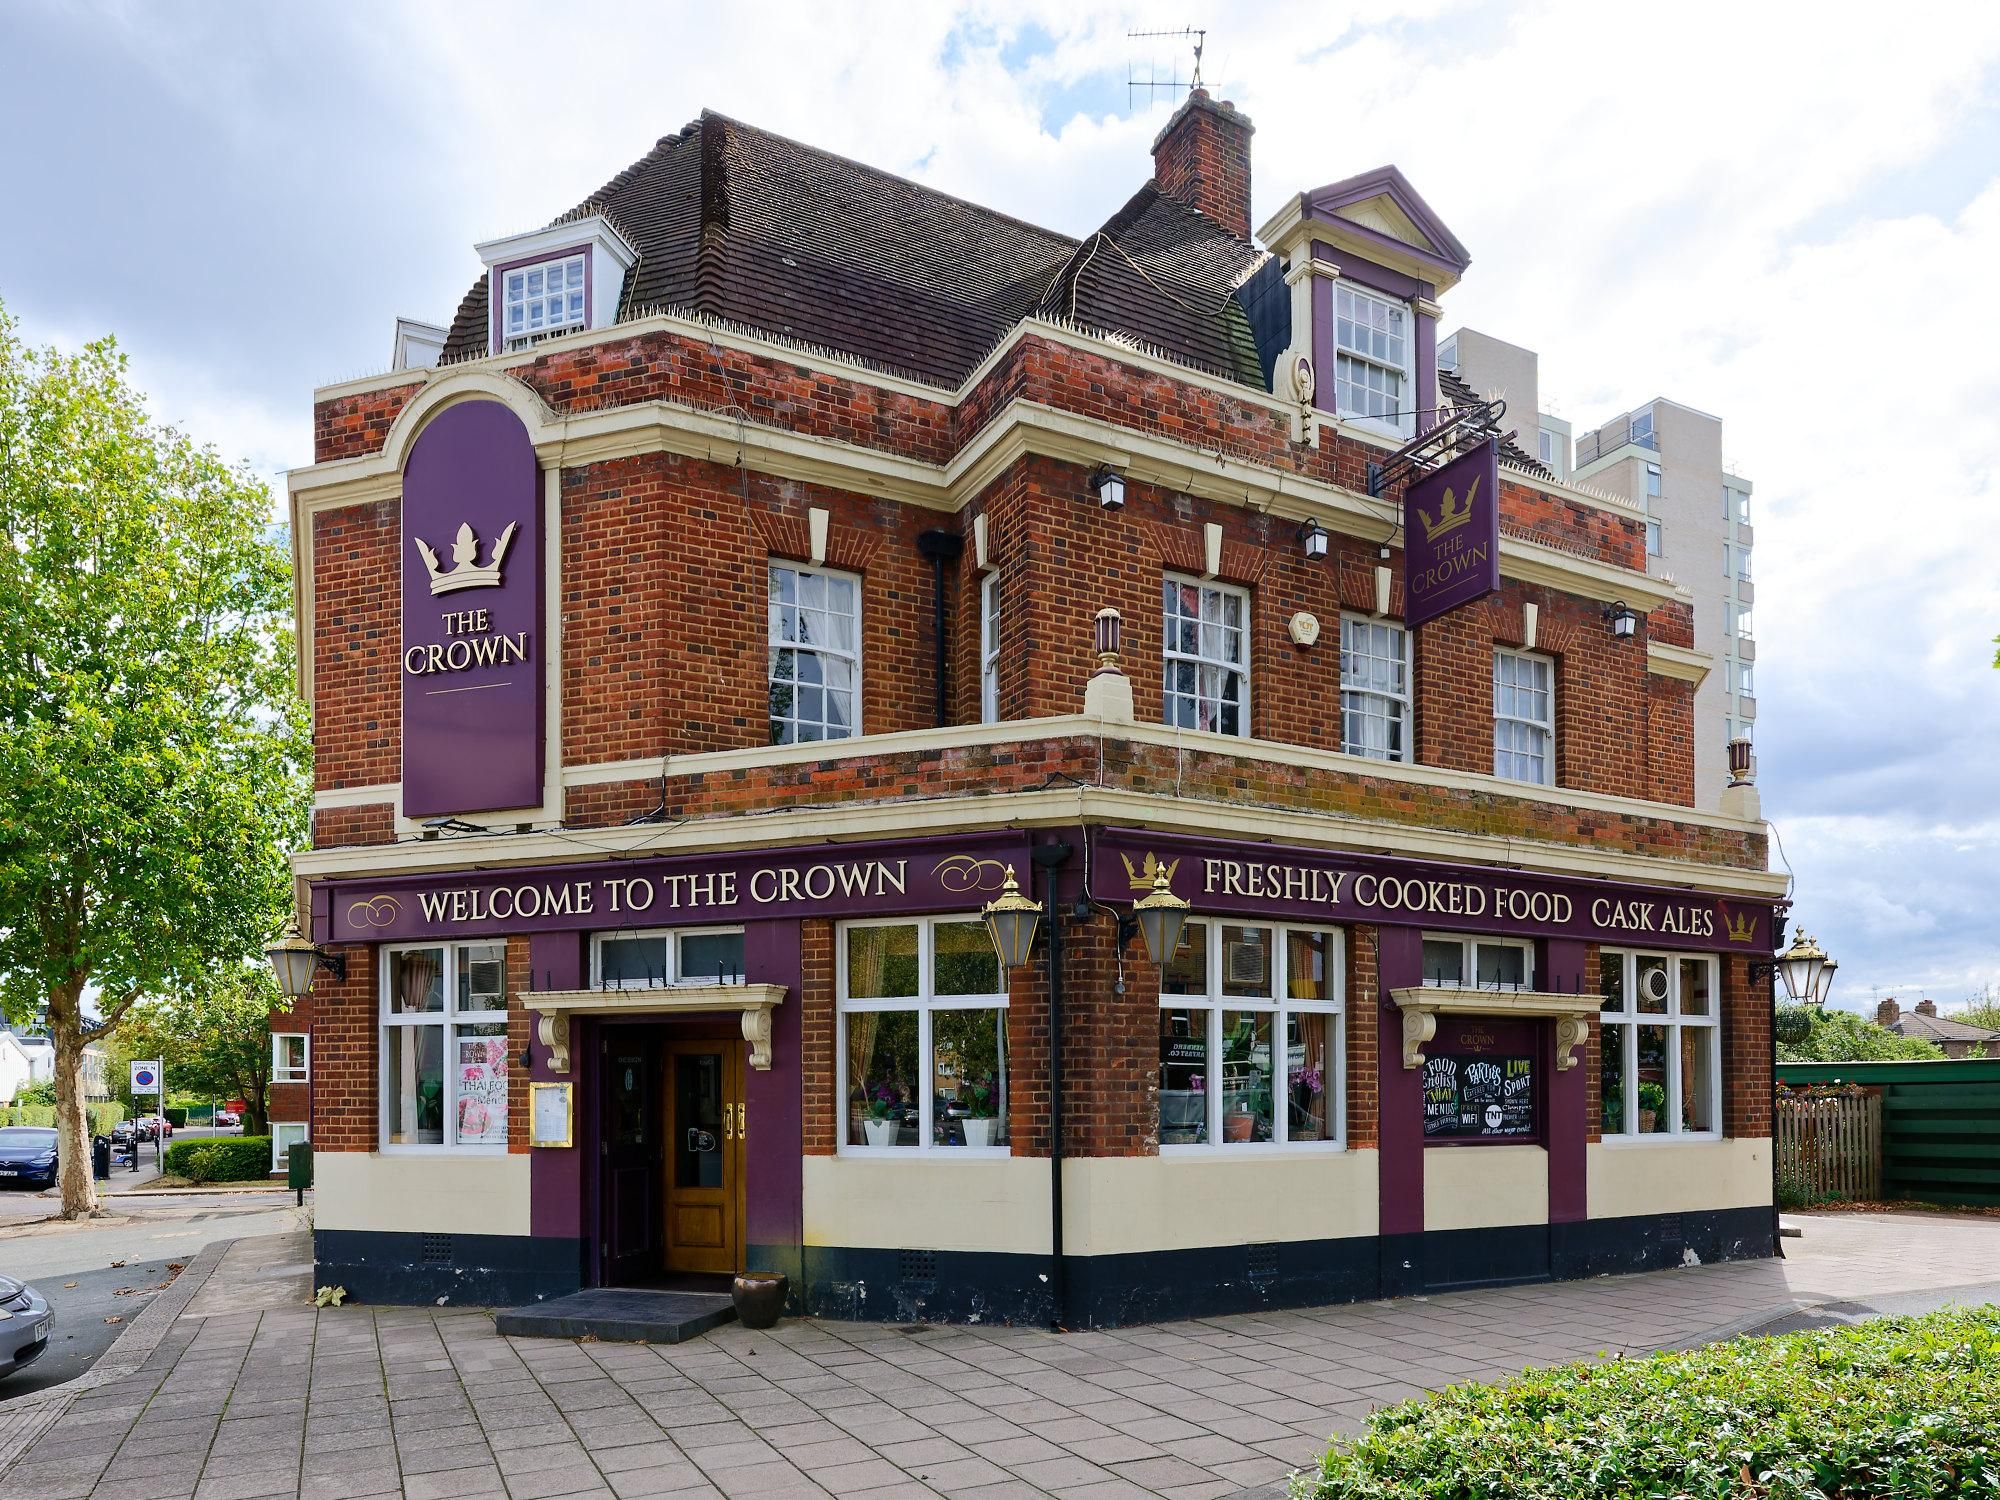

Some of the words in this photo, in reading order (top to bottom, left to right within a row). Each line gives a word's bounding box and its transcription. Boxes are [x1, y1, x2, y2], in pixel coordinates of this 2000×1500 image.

[1433, 534, 1464, 560] THE
[1412, 540, 1488, 594] CROWN
[441, 608, 489, 635] THE
[404, 632, 527, 675] CROWN
[417, 881, 594, 923] WELCOME
[603, 877, 654, 912] TO
[663, 871, 739, 908] THE
[750, 860, 908, 903] CROWN
[1203, 858, 1348, 904] FRESHLY
[1355, 873, 1487, 916] COOKED
[1494, 887, 1573, 924] FOOD
[1591, 898, 1656, 932] CASK
[1660, 904, 1714, 937] ALES
[1460, 1034, 1495, 1045] CROWN
[1425, 1058, 1457, 1076] FOOD
[1465, 1062, 1502, 1086] PARTIES
[1506, 1060, 1531, 1077] LIVE
[462, 1081, 487, 1091] THAI
[1422, 1071, 1457, 1091] English
[1504, 1075, 1531, 1097] SPORT
[1427, 1102, 1455, 1116] MENUS
[1461, 1113, 1478, 1125] WIFI
[1486, 1110, 1503, 1120] TNT
